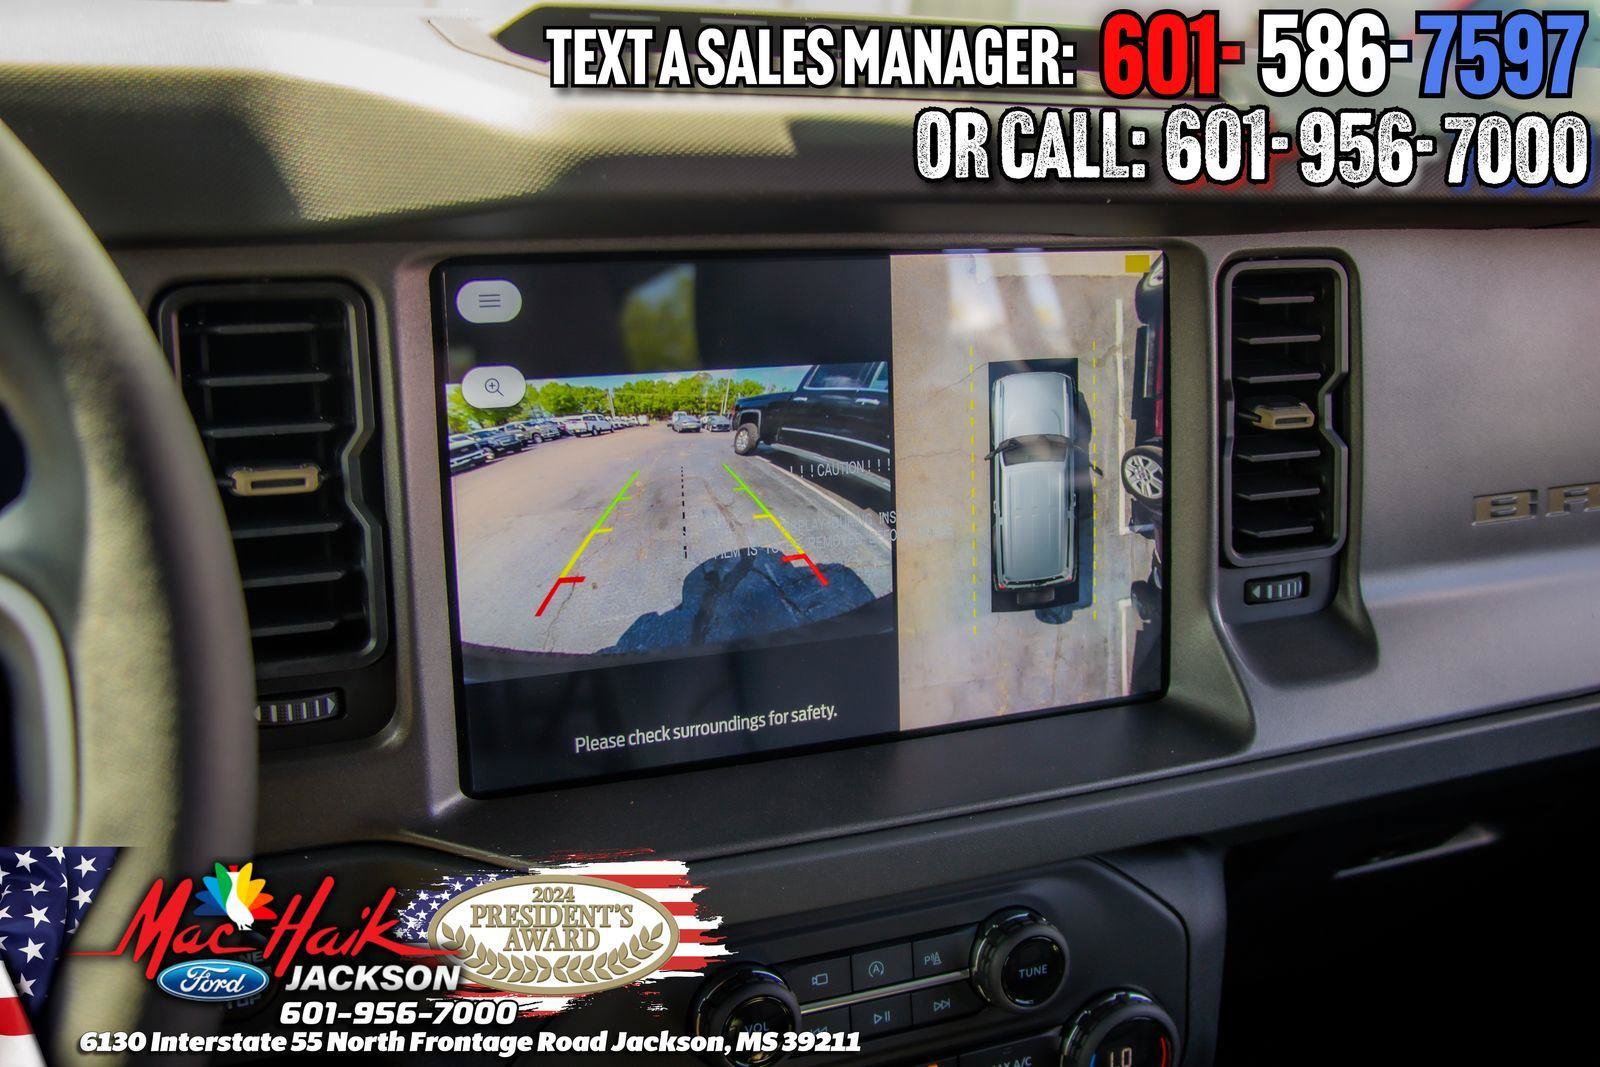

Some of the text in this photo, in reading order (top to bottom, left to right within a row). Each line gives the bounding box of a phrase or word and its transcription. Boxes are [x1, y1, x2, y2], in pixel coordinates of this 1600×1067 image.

[575, 703, 838, 754] Please check surroundings for safety.
[1019, 964, 1048, 979] TUNE
